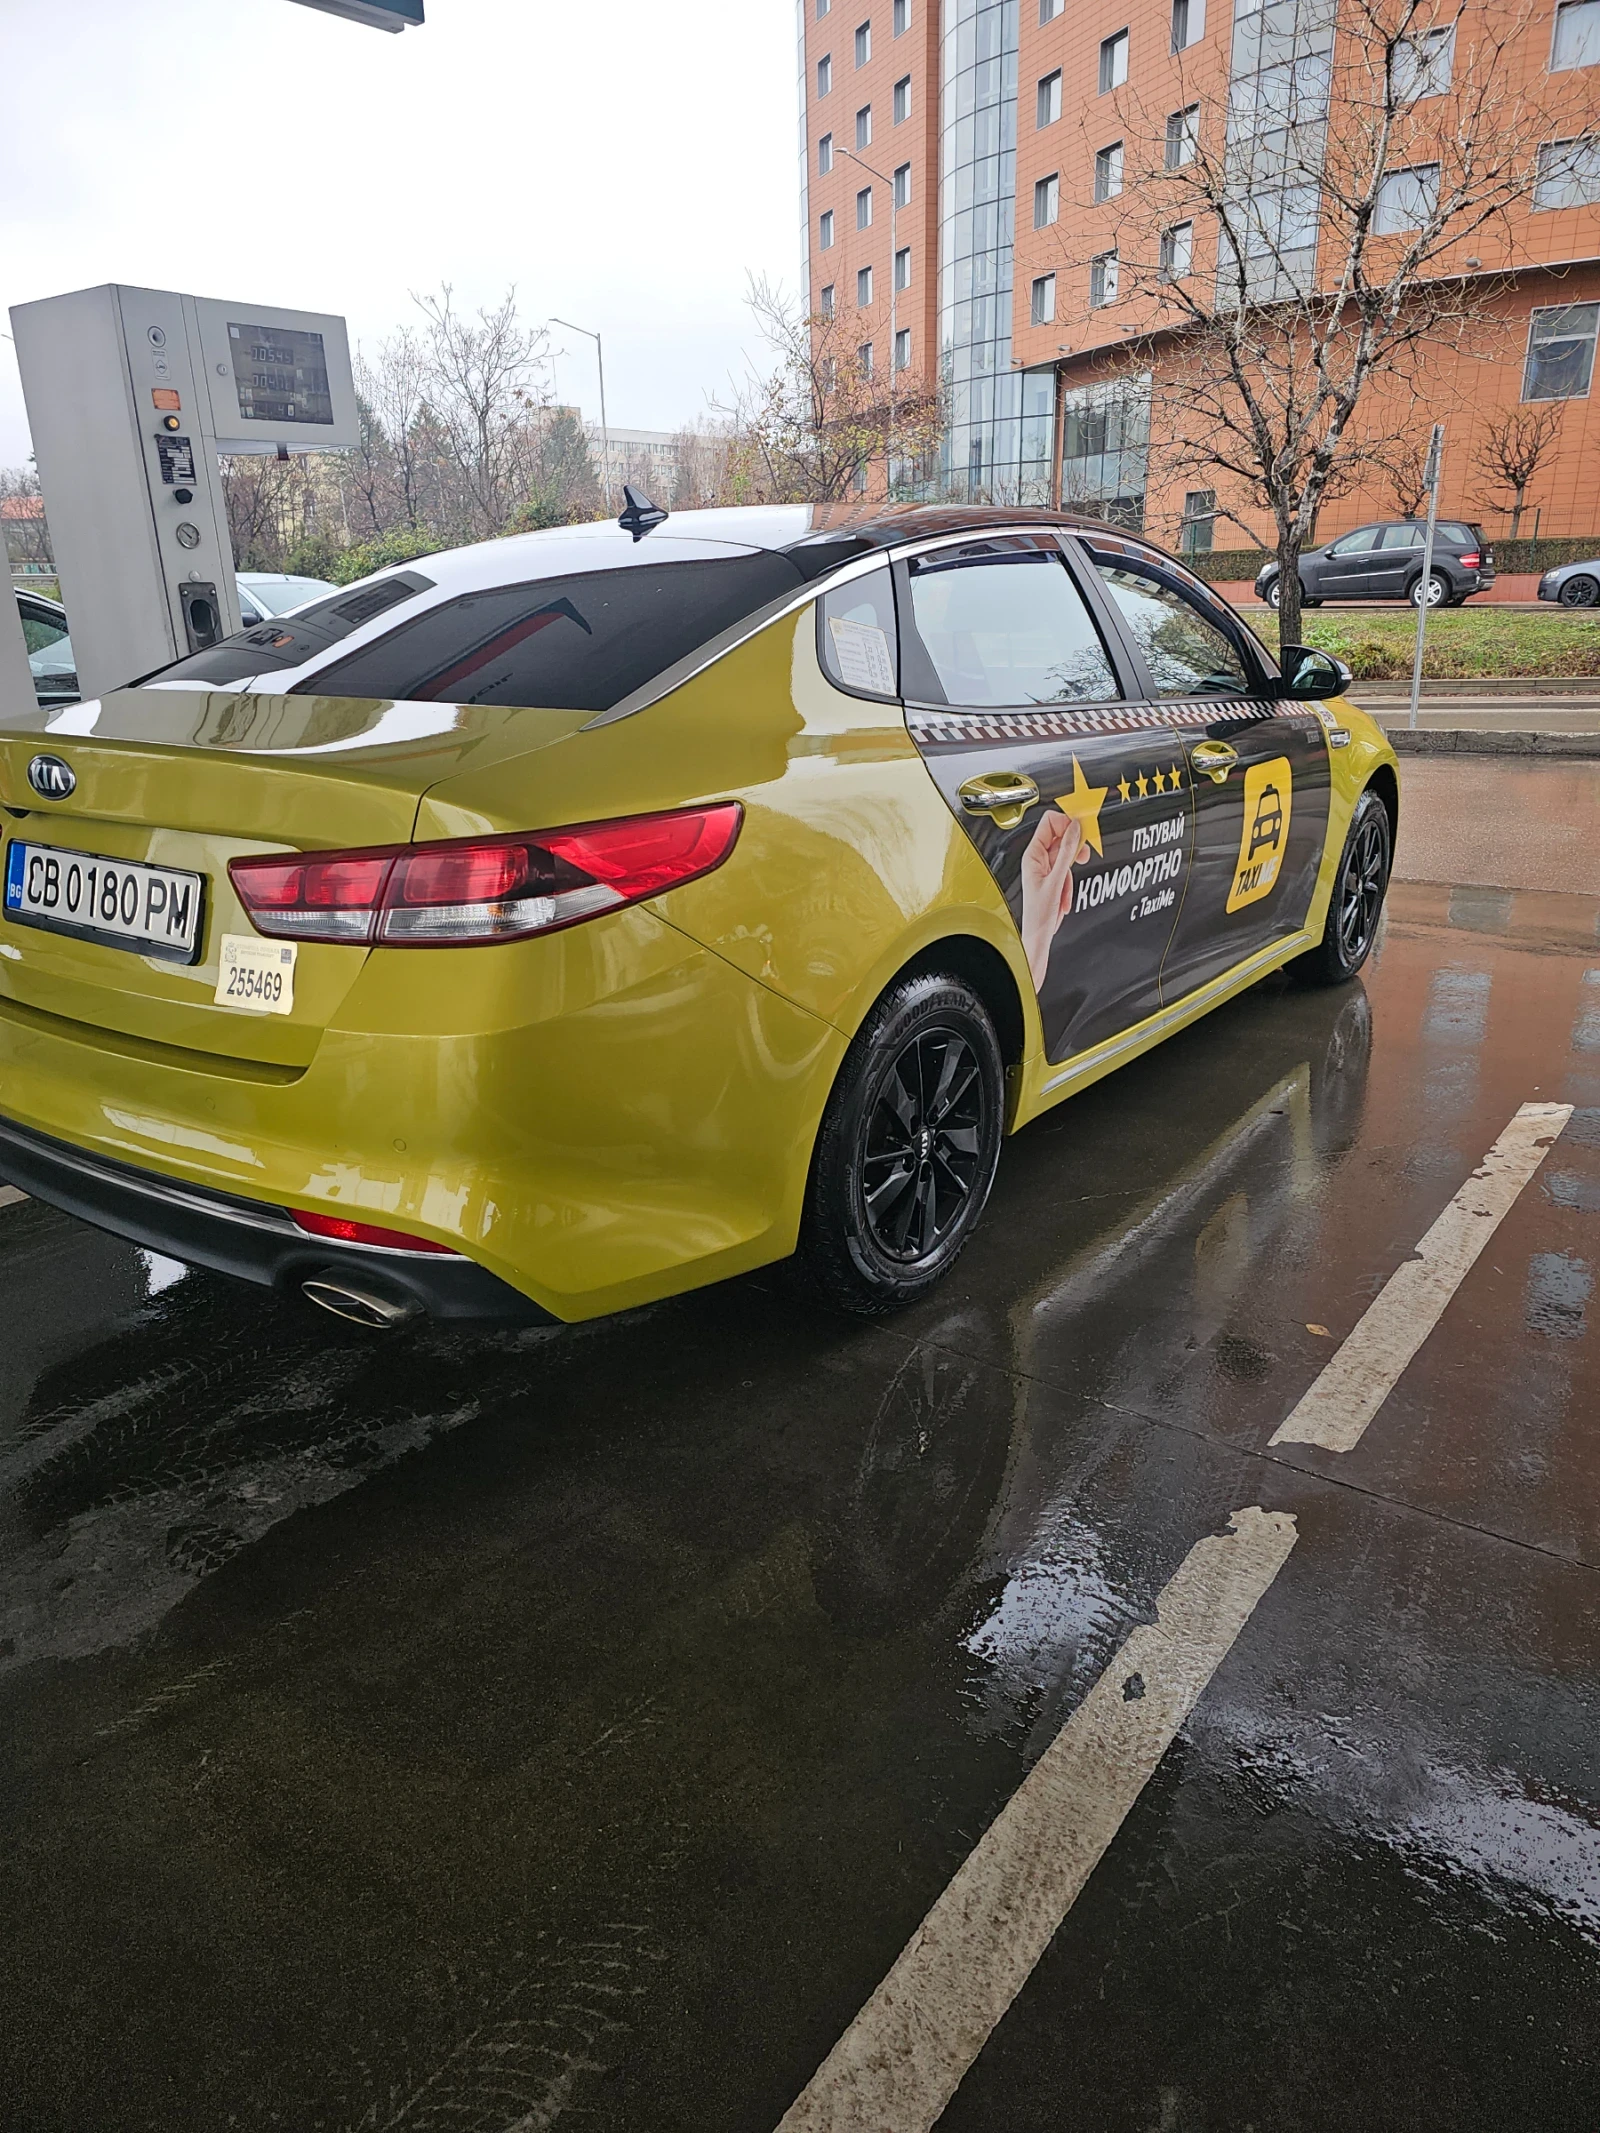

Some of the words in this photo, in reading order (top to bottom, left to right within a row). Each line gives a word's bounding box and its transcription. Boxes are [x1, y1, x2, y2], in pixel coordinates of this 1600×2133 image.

[30, 758, 67, 791] KIA
[1131, 811, 1185, 853] ПЪТУВАЙ
[9, 884, 22, 899] BG
[1075, 848, 1182, 913] КОМФОРТНО
[1139, 887, 1175, 918] TaxiMe
[226, 966, 282, 1002] 255469
[920, 1131, 929, 1158] KIA
